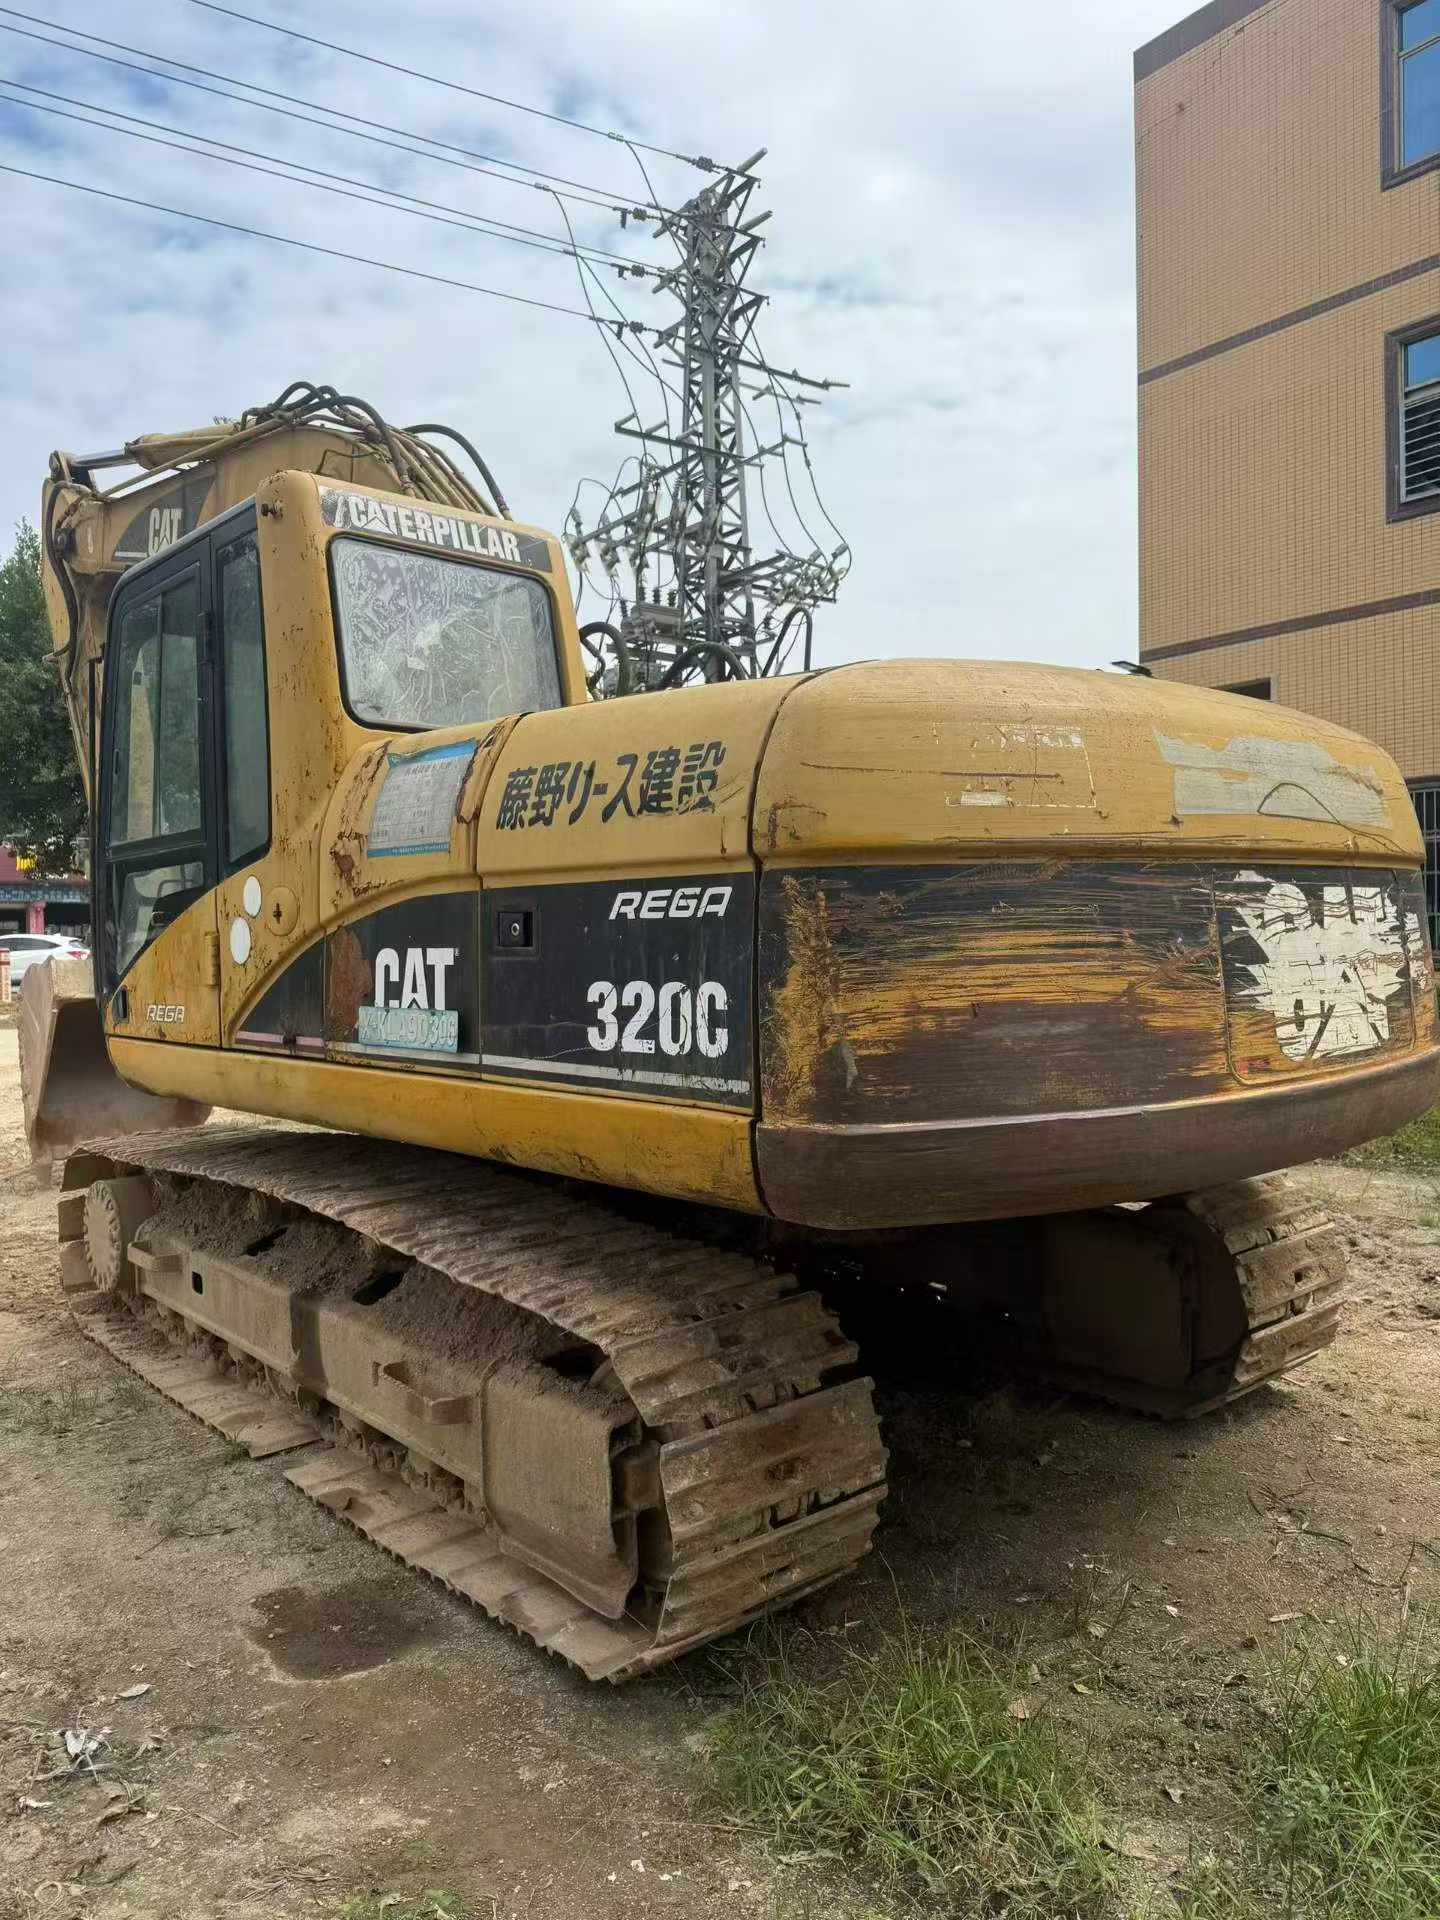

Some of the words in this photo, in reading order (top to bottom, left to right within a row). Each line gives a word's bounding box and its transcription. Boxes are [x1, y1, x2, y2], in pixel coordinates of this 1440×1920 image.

[148, 507, 184, 557] CAT
[348, 495, 521, 563] CATERPILLAR
[496, 740, 727, 831] 藤野リース建設
[609, 886, 733, 921] REGA
[374, 947, 455, 1012] CAT
[146, 1004, 186, 1023] REGA
[586, 980, 729, 1058] 320C
